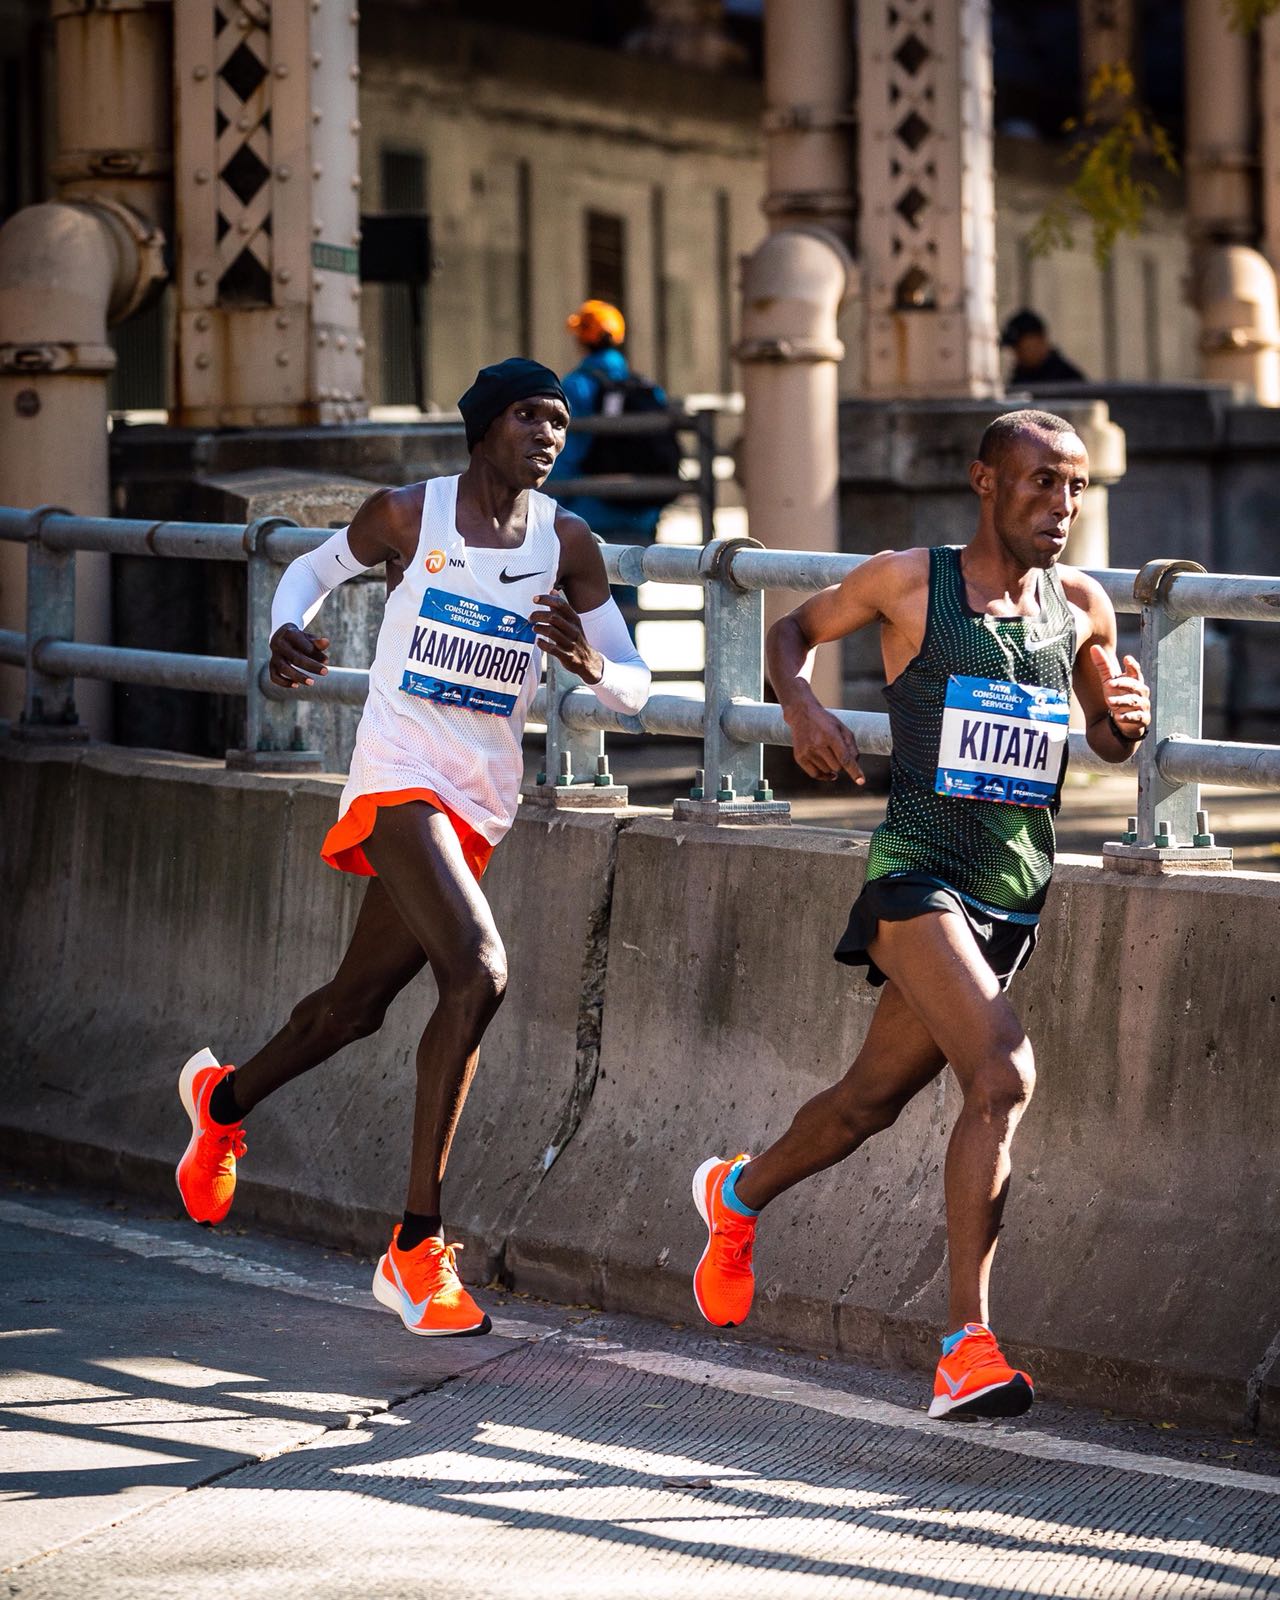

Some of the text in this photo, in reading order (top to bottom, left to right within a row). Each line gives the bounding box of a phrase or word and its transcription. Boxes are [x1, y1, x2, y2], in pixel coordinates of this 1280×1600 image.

[448, 558, 465, 568] NN
[444, 604, 491, 622] CONSULTANCY
[459, 600, 479, 611] TATA
[450, 613, 481, 628] SERVICES
[497, 625, 514, 633] TATA
[408, 625, 530, 685] KAMWOROR
[988, 683, 1011, 694] TATA
[972, 689, 1024, 704] CONSULTANCY
[981, 699, 1014, 711] SERVICES
[959, 719, 1049, 771] KITATA
[971, 775, 1030, 802] 2018
